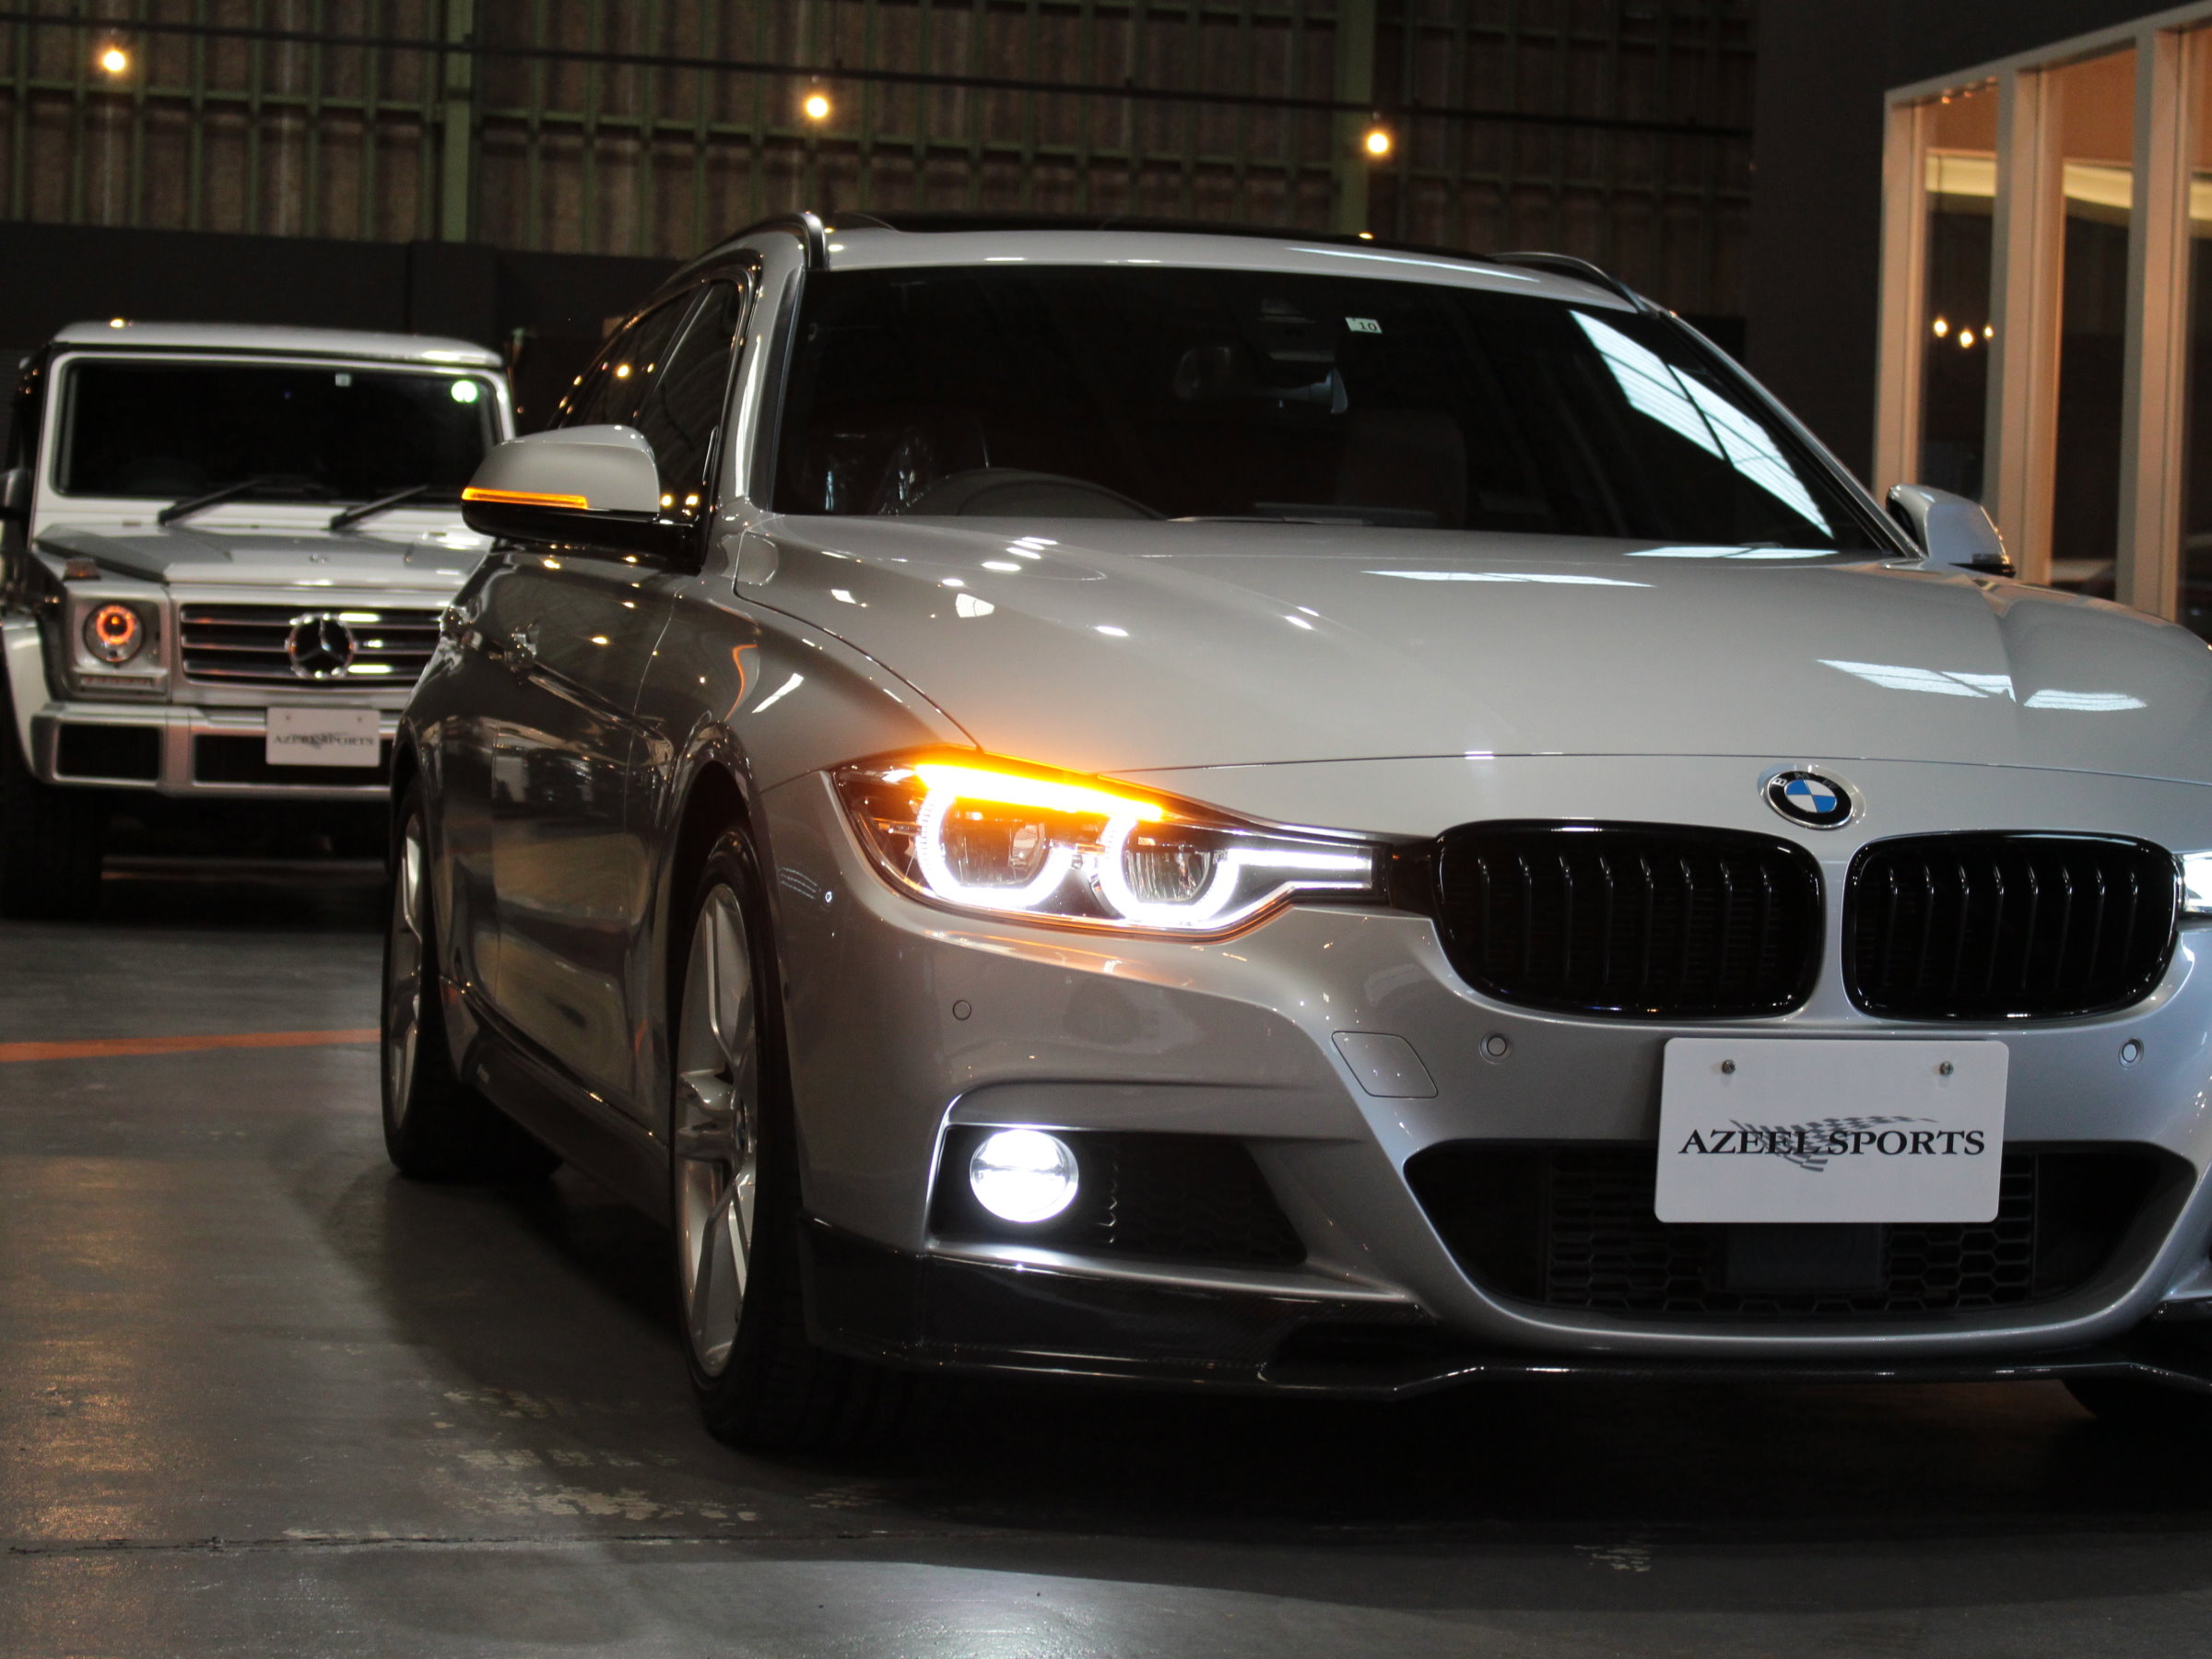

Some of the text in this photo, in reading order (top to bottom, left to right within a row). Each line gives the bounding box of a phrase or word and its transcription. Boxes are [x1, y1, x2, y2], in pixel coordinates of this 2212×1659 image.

[1359, 322, 1378, 332] 10
[1678, 1129, 1985, 1155] AZEEL SPORTS
